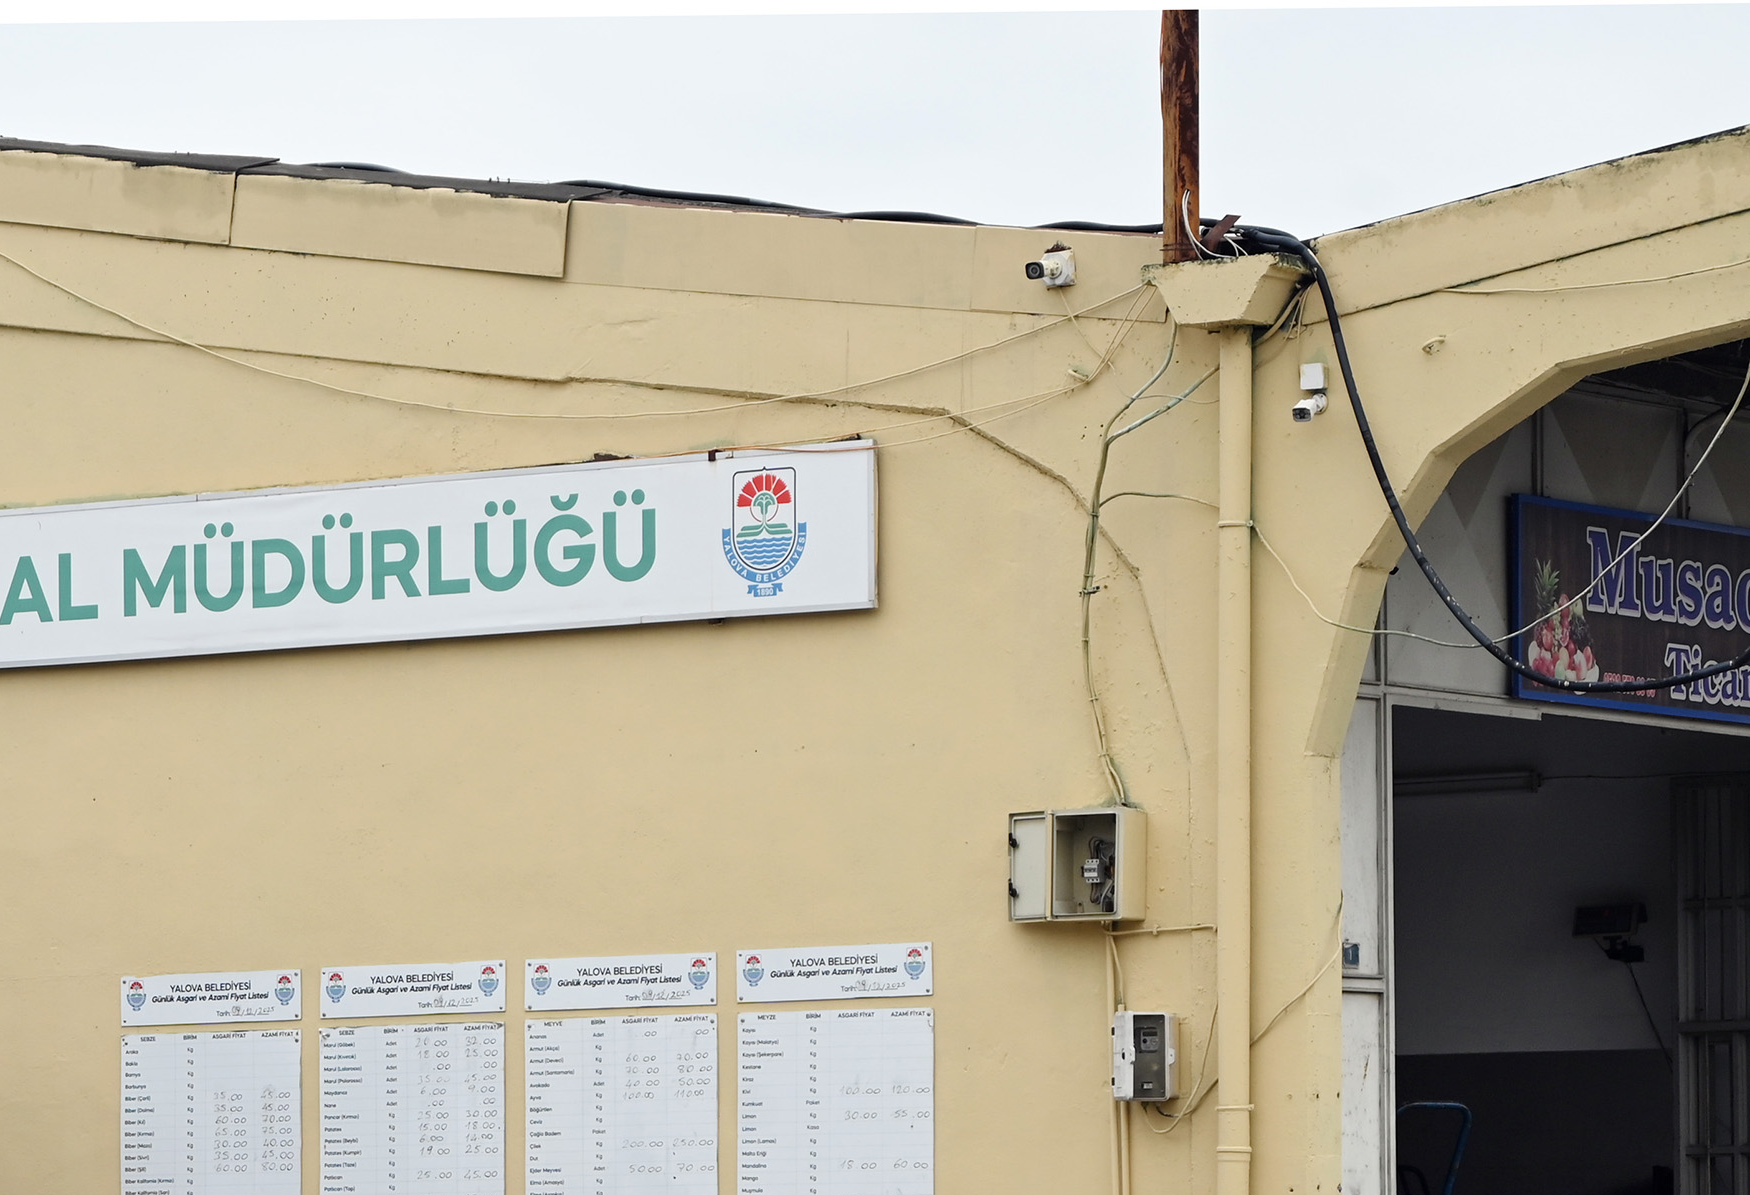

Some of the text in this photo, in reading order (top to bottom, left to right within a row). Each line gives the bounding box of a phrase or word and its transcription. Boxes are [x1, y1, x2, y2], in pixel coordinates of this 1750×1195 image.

[122, 487, 657, 618] MÜDÜRLÜĞÜ
[789, 953, 879, 968] YALOVA BELEDİYESİ
[576, 962, 663, 977] YALOVA BELEDİYESİ
[769, 969, 795, 979] Günlük
[821, 968, 830, 976] ve
[855, 966, 874, 977] Fiyat
[874, 964, 899, 974] Listesi
[369, 970, 454, 985] YALOVA BELEDİYESİ
[557, 978, 582, 988] Günlük
[606, 978, 616, 986] ve
[640, 975, 658, 986] Fiyat
[659, 974, 683, 983] Listesi
[169, 979, 252, 994] YALOVA BELEDİYESİ
[351, 986, 375, 995] Günlük
[432, 983, 449, 993] Fiyat
[450, 982, 473, 991] Listesi
[151, 995, 175, 1004] Günlük
[230, 992, 247, 1002] Fiyat
[248, 991, 270, 1000] Listesi
[214, 1115, 247, 1125] 60.00
[844, 1110, 878, 1121] 30.00
[213, 1150, 249, 1161] 35.00
[463, 1169, 498, 1180] 45.00
